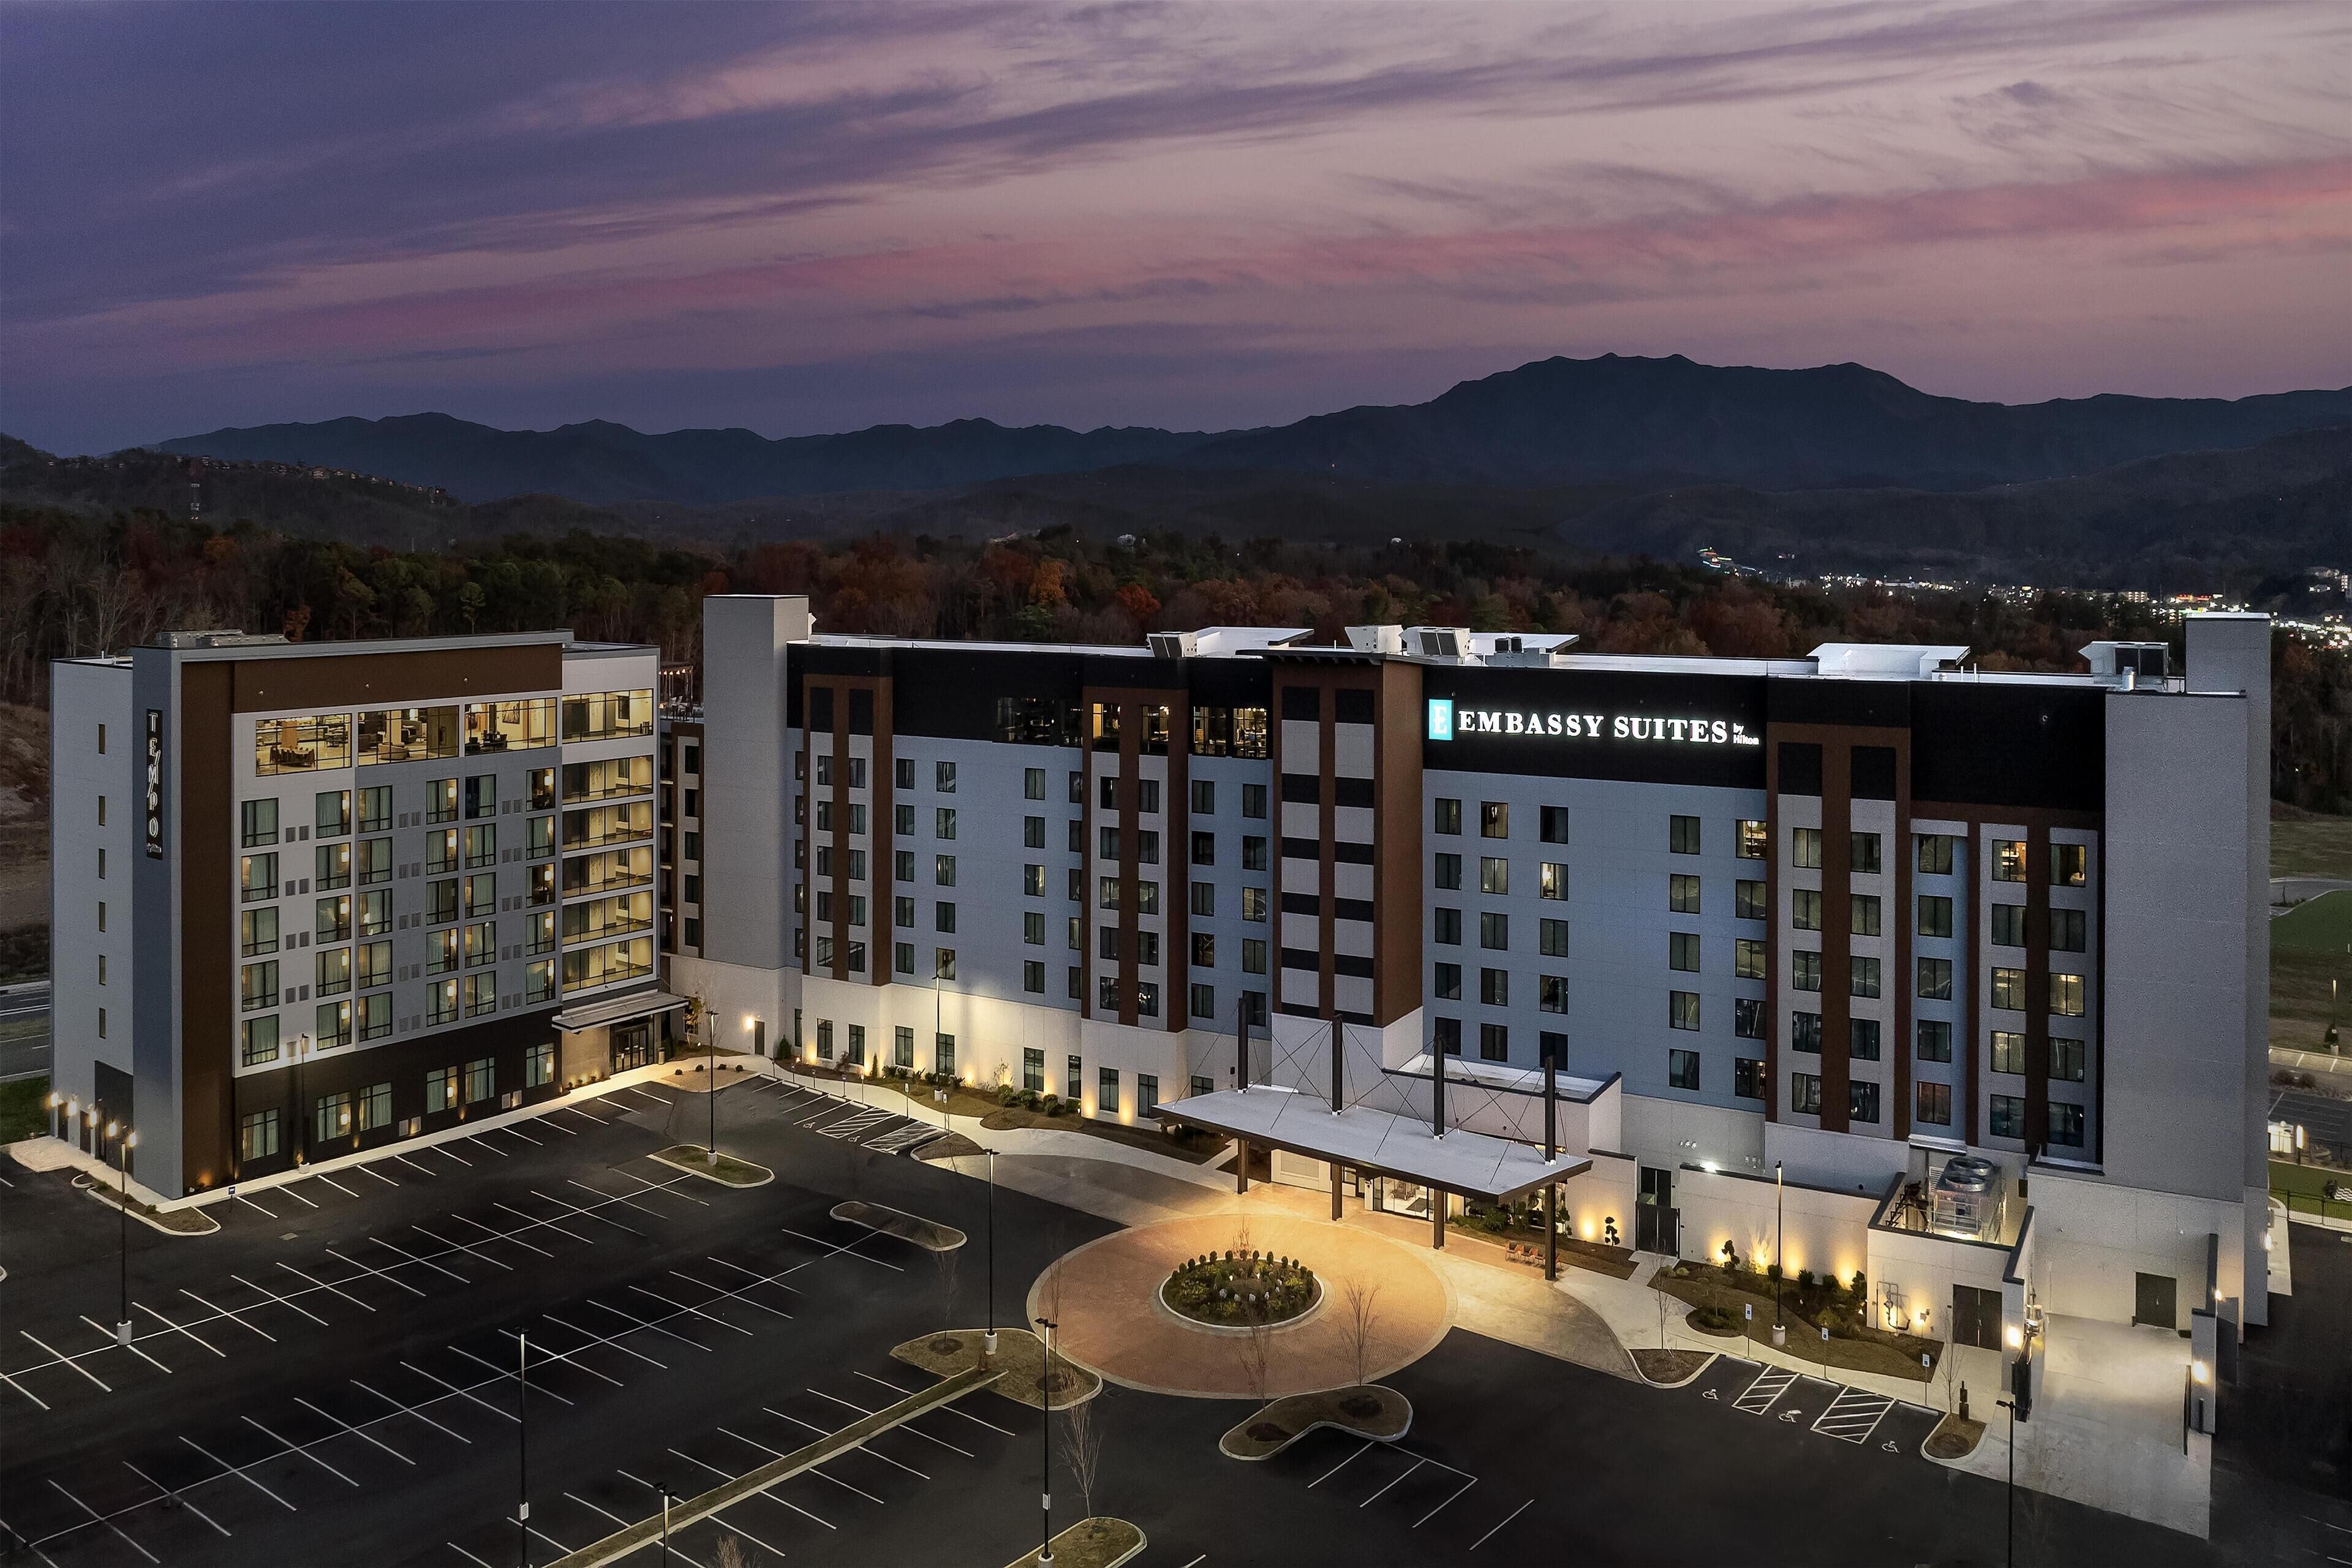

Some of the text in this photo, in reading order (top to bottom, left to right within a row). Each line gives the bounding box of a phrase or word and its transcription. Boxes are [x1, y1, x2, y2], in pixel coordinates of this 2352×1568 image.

[1458, 710, 1727, 744] EMBASSY SUITES
[1733, 723, 1744, 735] by
[1733, 734, 1759, 745] Hilton
[148, 712, 161, 838] TEMPO
